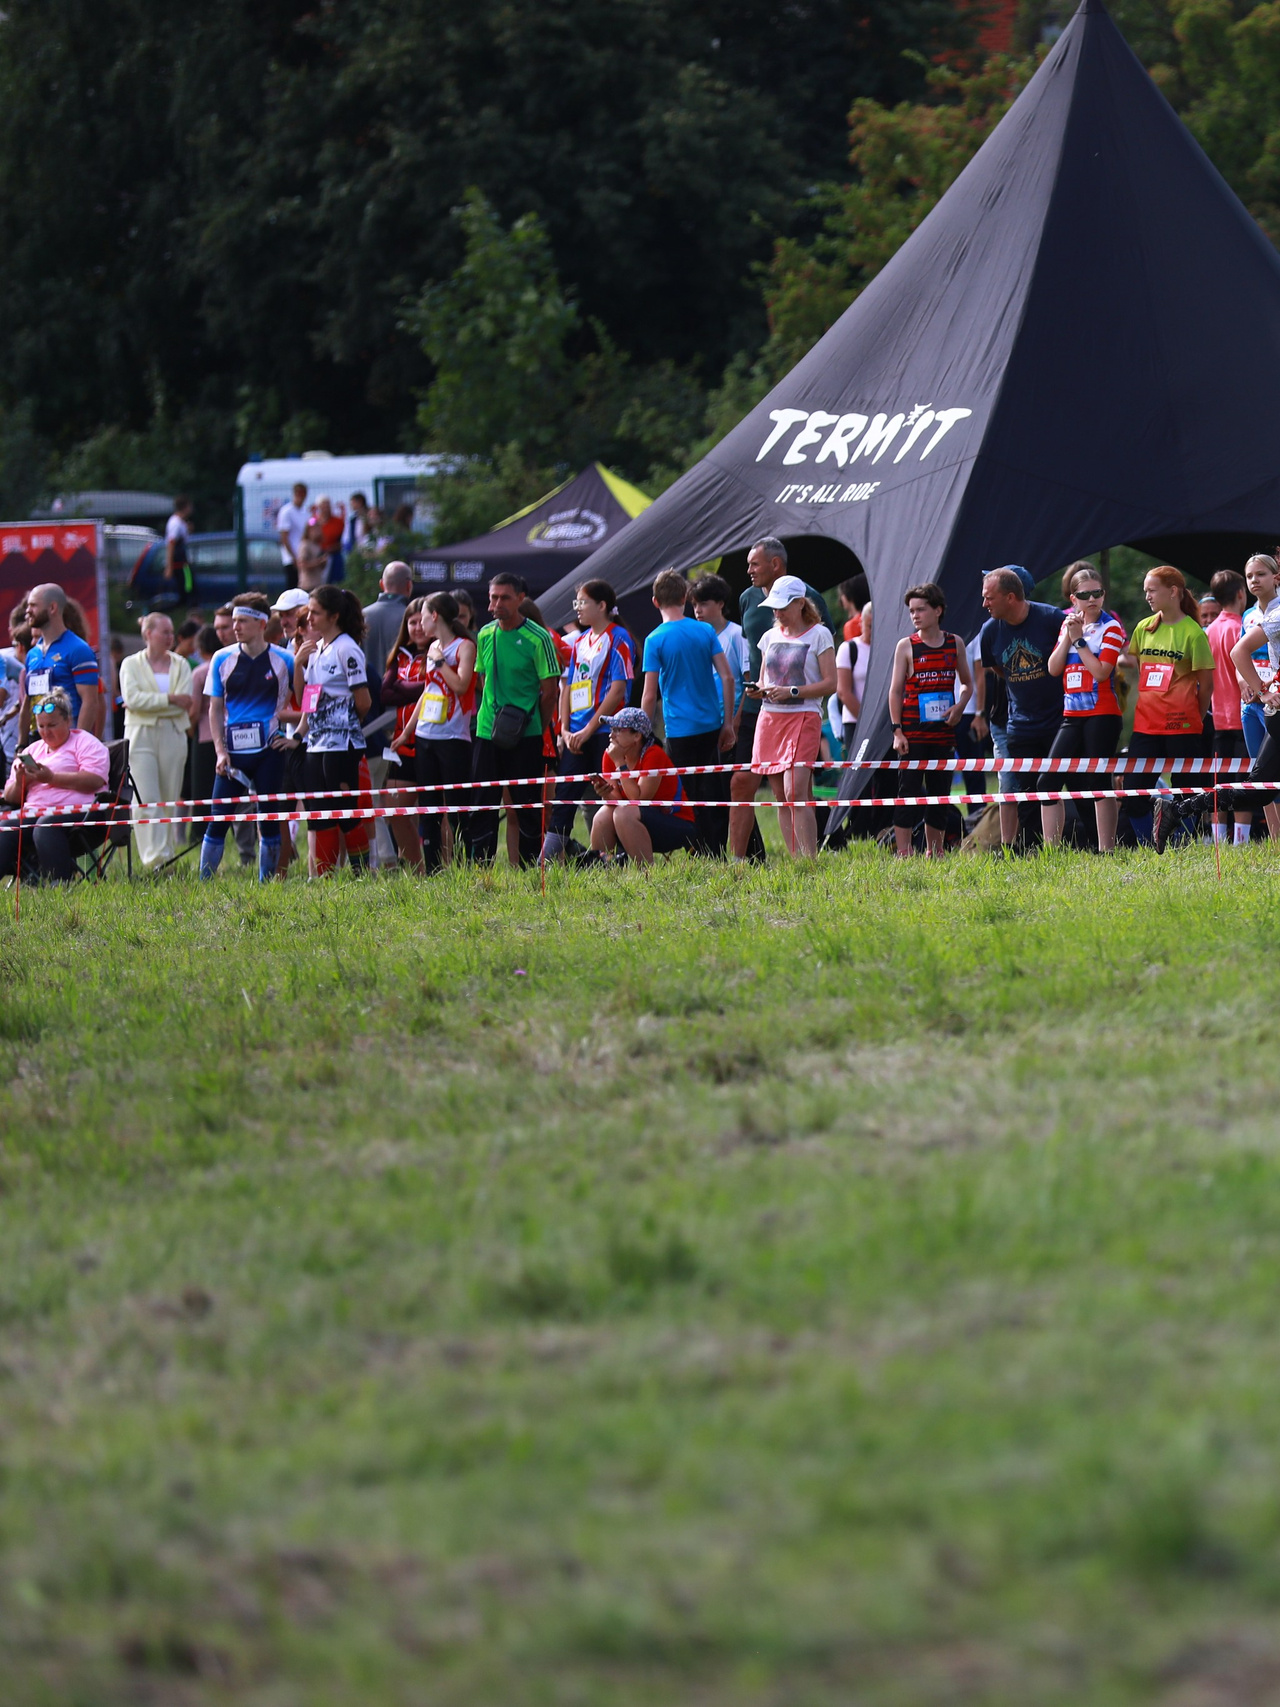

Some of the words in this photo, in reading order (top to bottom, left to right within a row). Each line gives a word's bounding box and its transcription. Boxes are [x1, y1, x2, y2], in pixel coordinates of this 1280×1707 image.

[755, 404, 973, 468] TERMIT
[774, 484, 815, 503] IT'S
[808, 483, 842, 503] ALL
[838, 481, 881, 503] RIDE
